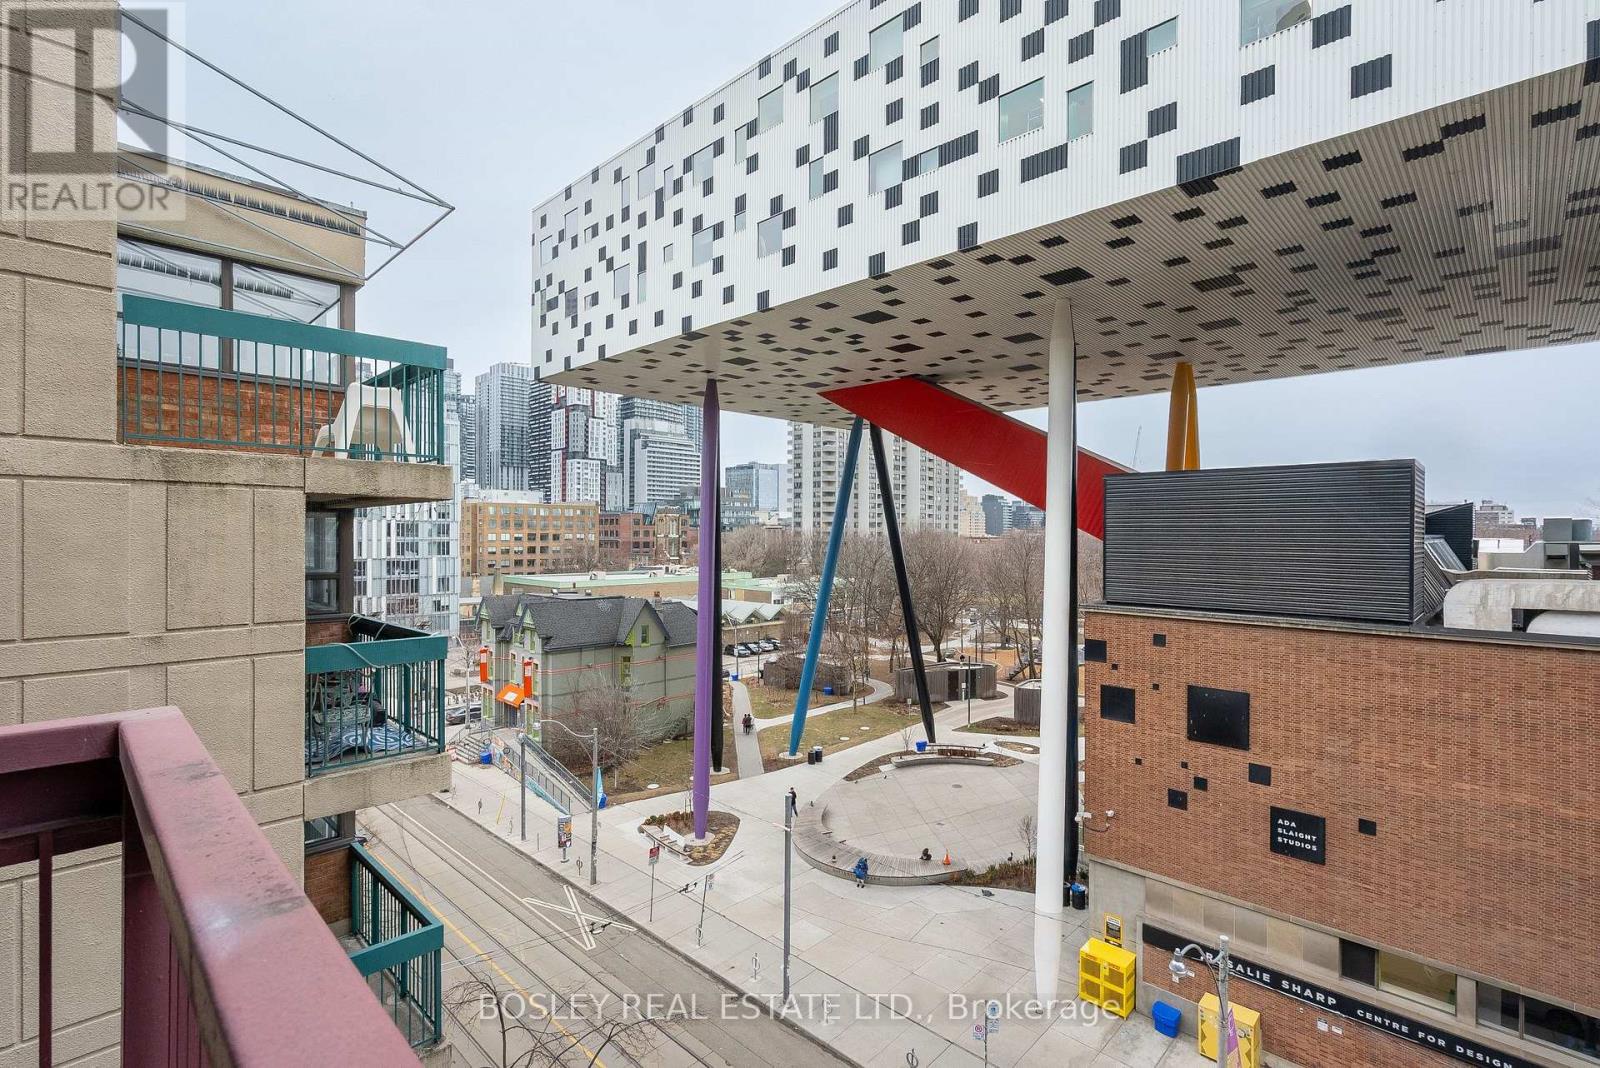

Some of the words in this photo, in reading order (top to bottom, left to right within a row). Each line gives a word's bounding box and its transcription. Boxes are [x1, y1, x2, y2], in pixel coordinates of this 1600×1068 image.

[1277, 818, 1297, 828] ADA
[1277, 827, 1317, 842] SLAIGHT
[1277, 836, 1317, 851] STUDIOS
[1281, 980, 1337, 1006] SHARP
[1356, 1009, 1409, 1034] CENTRE
[1418, 1031, 1447, 1047] FOR
[1455, 1045, 1513, 1068] DESIGN
